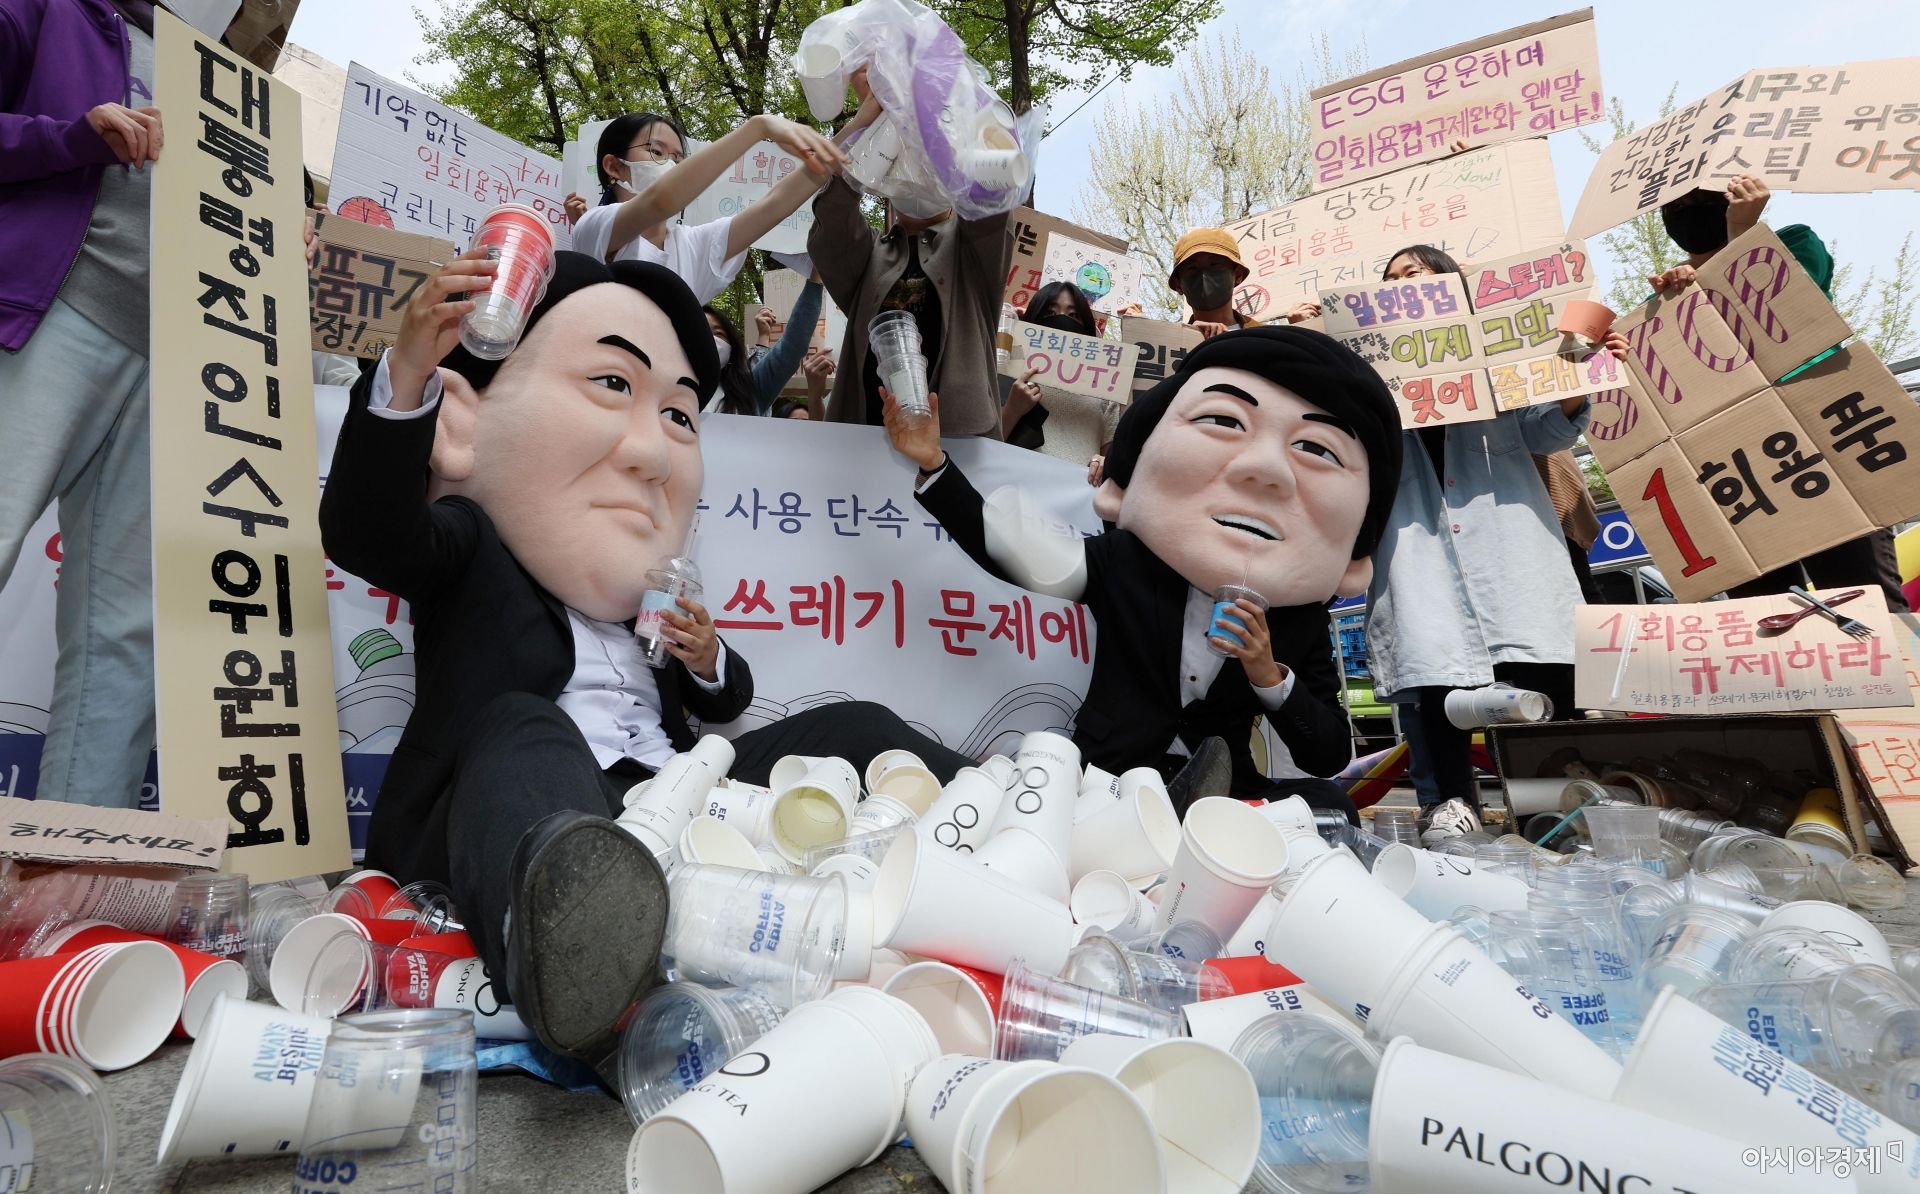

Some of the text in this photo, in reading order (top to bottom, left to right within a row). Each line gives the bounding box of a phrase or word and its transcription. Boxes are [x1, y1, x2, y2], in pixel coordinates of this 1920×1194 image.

[1320, 40, 1545, 130] ESG 운운하며
[355, 81, 467, 157] 기약 없는
[1315, 100, 1522, 185] 일회용컵규제완화
[1625, 71, 1850, 160] 건강한 지구와
[417, 145, 508, 204] 일회용컵
[508, 151, 559, 188] 규제
[1453, 167, 1502, 185] Now!
[1610, 134, 1692, 194] 건강한
[1702, 106, 1823, 146] 우리를
[1636, 141, 1812, 210] 플라스틱
[378, 180, 454, 235] 코로나
[1233, 173, 1431, 244] 지금 당장!!
[1254, 194, 1470, 278] 일회용품 사용을
[305, 241, 428, 320] 품규
[1343, 250, 1587, 328] 일회용컵 스토커?
[1023, 326, 1125, 368] 일회용품컵
[1390, 299, 1559, 369] 이제 그만
[1026, 352, 1121, 393] OUT!
[1402, 372, 1479, 424] 잊어
[194, 40, 310, 848] 대통령직인수위원회
[725, 487, 812, 534] 사용
[827, 494, 910, 539] 단속
[713, 574, 1091, 665] 쓰레기 문제에
[1590, 609, 1758, 654] 1회용품
[1679, 635, 1893, 695] 규제하라
[8, 822, 218, 858] 해주세요!
[409, 954, 418, 995] EDIYA
[418, 951, 430, 1001] COFFEE
[277, 1027, 309, 1086] BESIDE
[717, 1086, 750, 1117] TEA
